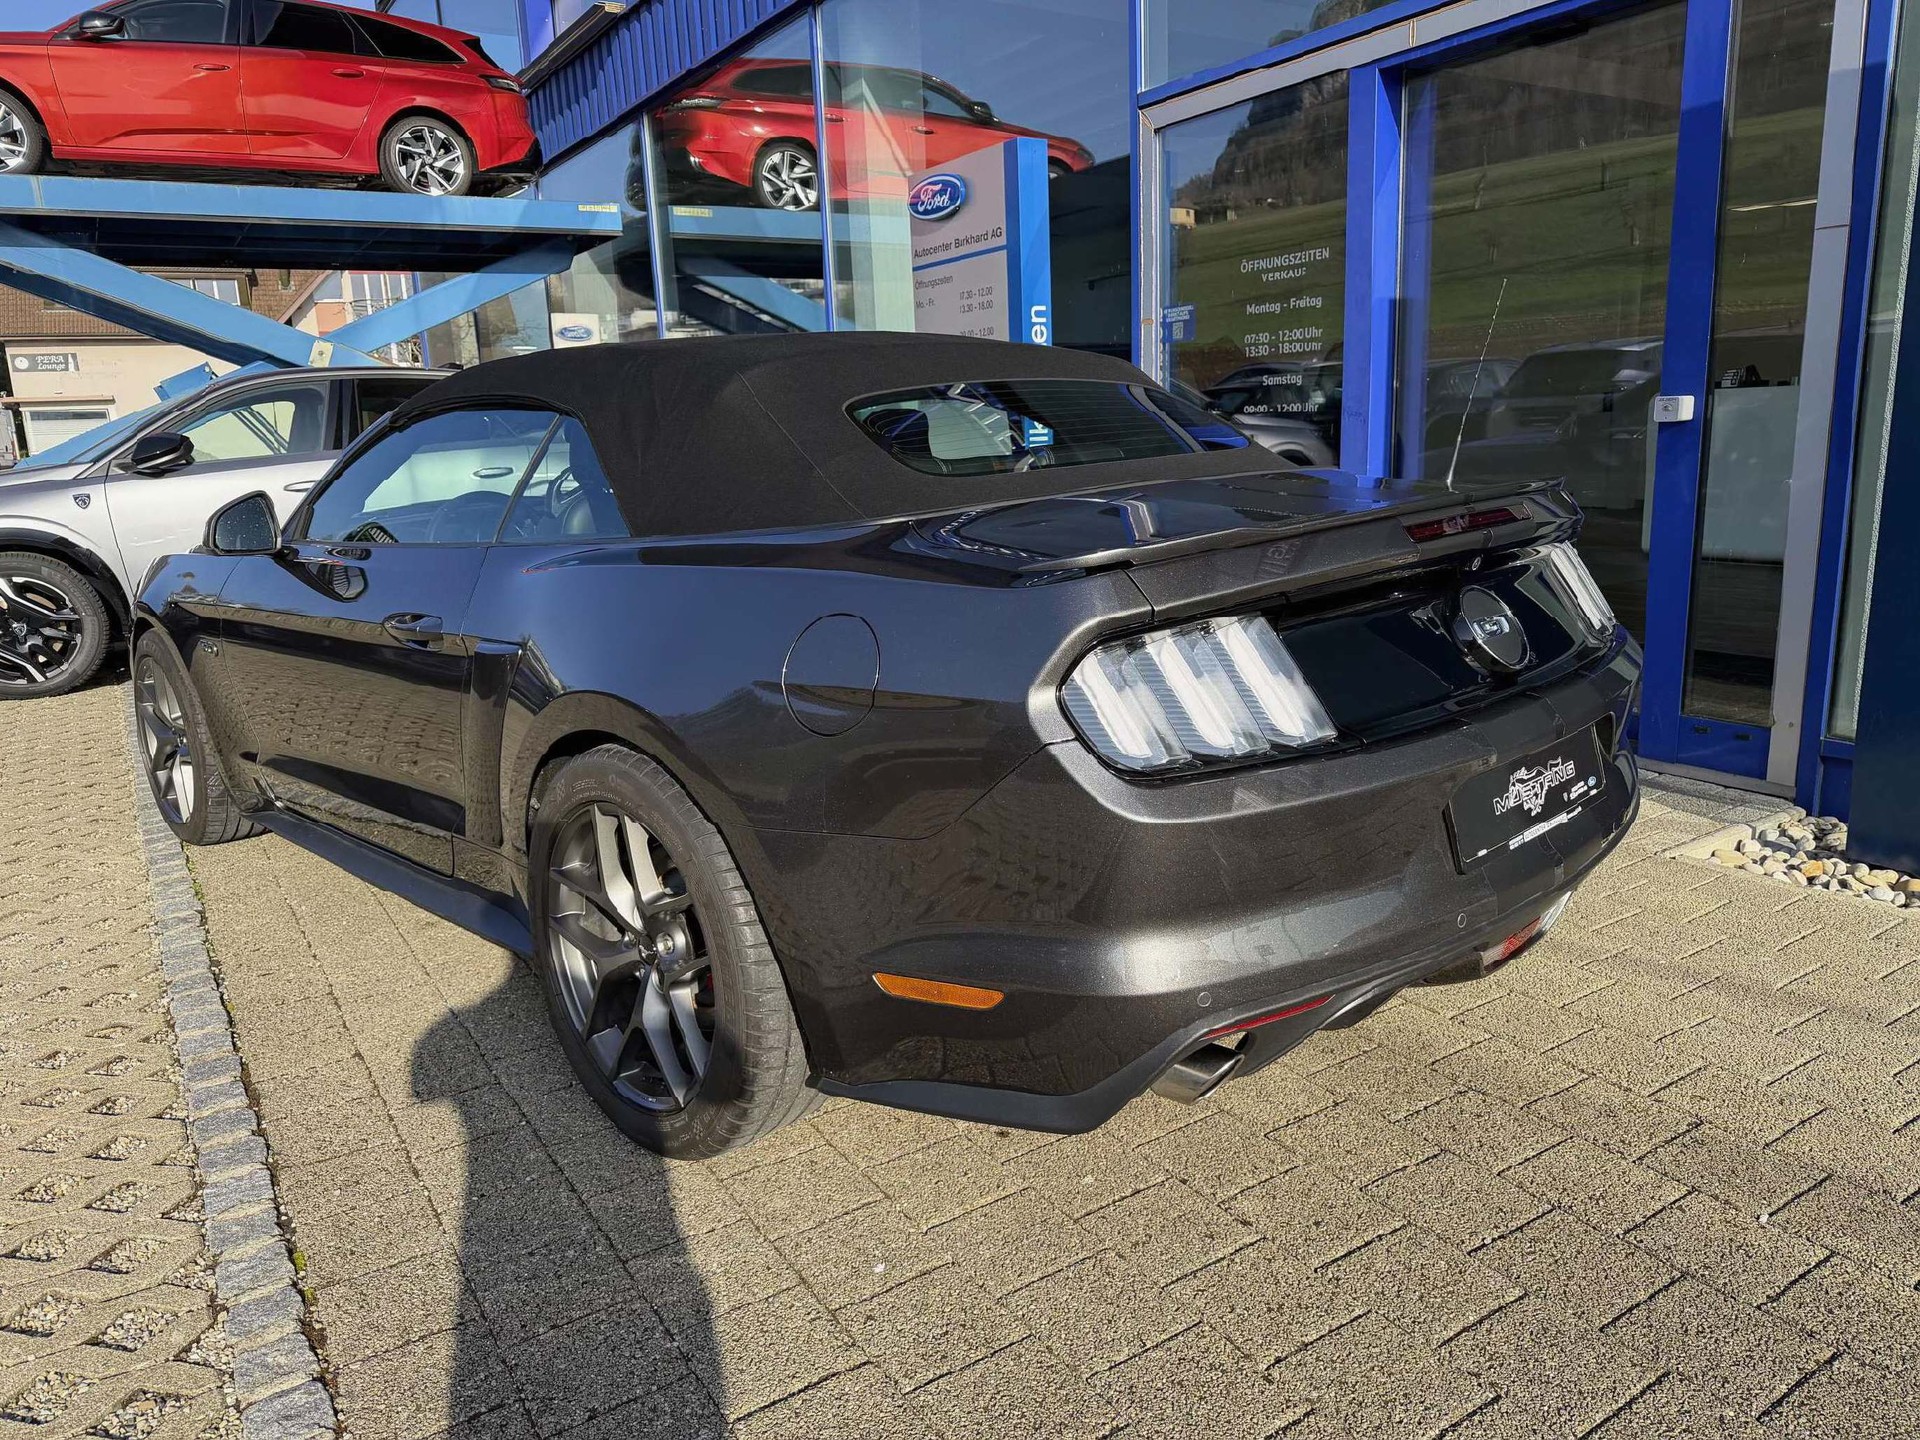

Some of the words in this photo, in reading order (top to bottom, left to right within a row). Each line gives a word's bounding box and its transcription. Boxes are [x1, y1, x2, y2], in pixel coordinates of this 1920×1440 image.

[917, 183, 951, 212] Ford
[913, 241, 953, 259] Autocenter
[990, 226, 1003, 240] AG
[1240, 246, 1330, 273] ÖFFNUNGSZEITEN
[1246, 302, 1281, 316] Montag
[1290, 296, 1323, 309] Freitag
[1244, 332, 1269, 344] 07:30
[1278, 328, 1304, 341] 12:00
[1304, 326, 1323, 338] Uhr
[36, 355, 65, 363] PERA
[1244, 344, 1269, 358] 13:30
[1278, 342, 1304, 354] 18:00
[1304, 342, 1323, 351] Uhr
[38, 363, 66, 372] Lounge
[1262, 374, 1303, 386] Samstag
[1302, 402, 1319, 413] Uhr
[1493, 760, 1576, 815] MUSTANG
